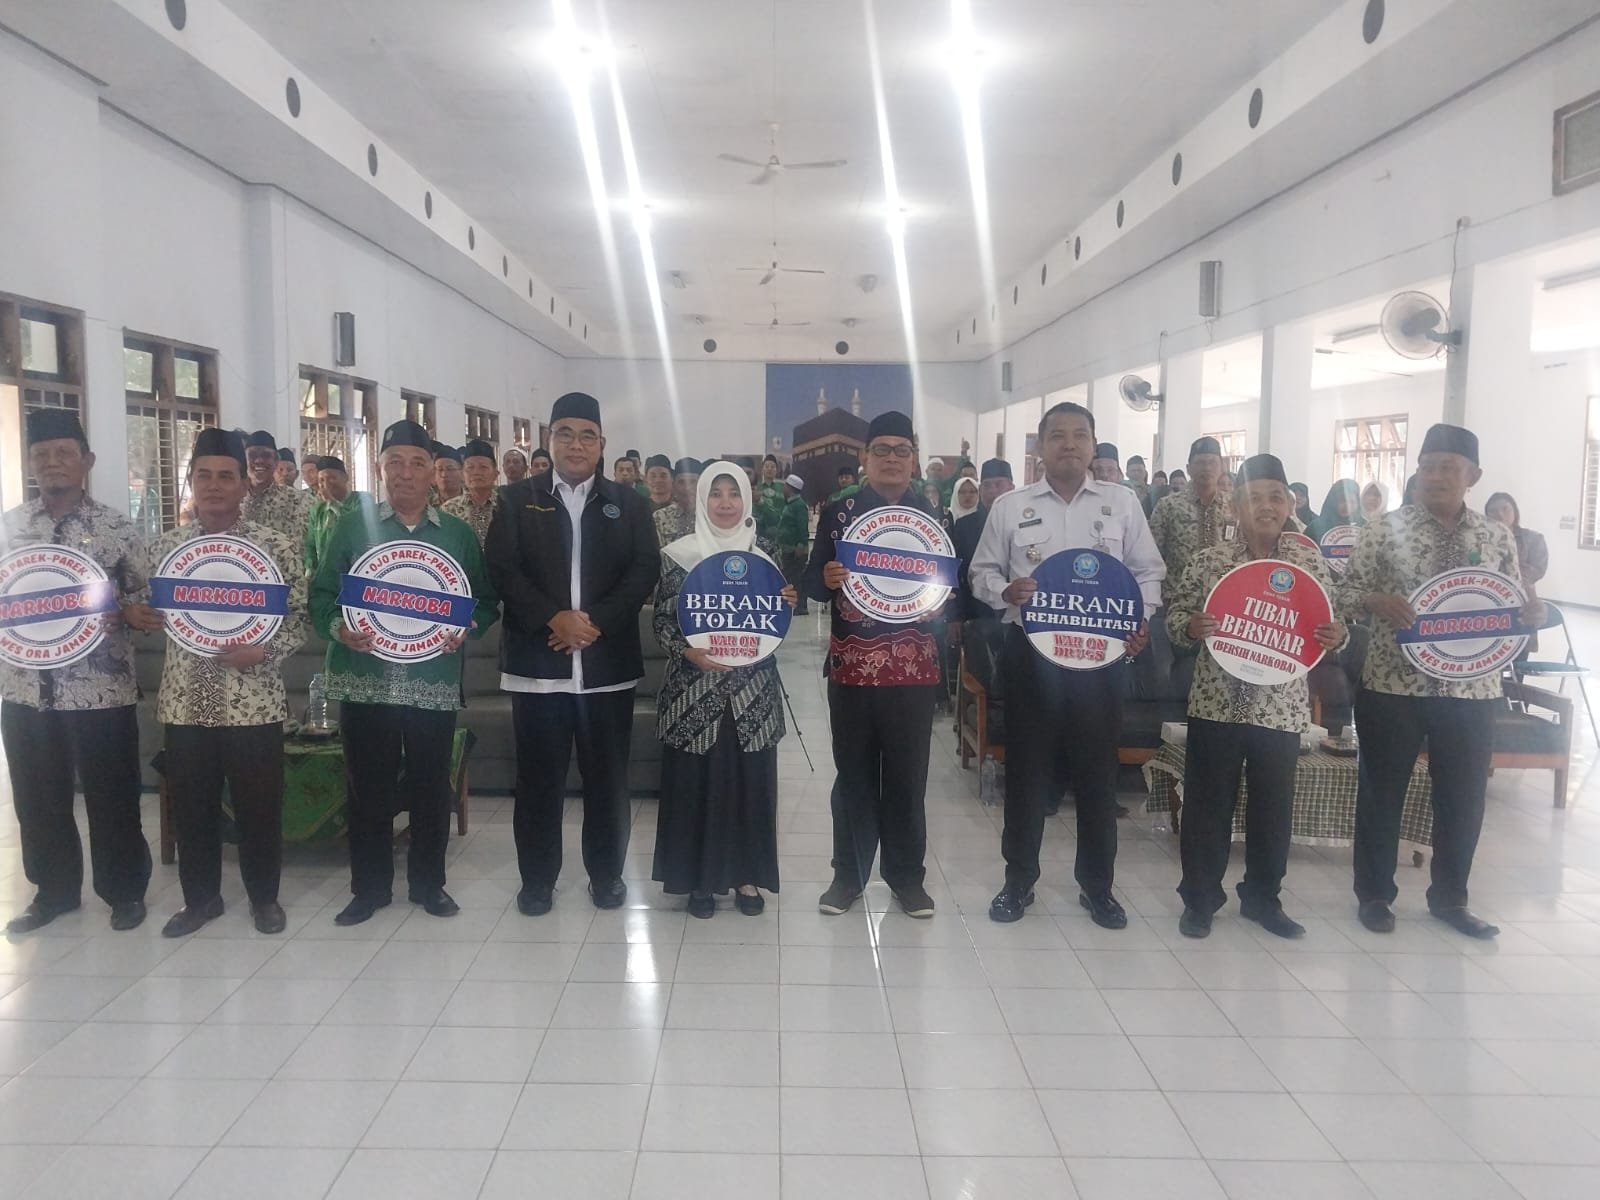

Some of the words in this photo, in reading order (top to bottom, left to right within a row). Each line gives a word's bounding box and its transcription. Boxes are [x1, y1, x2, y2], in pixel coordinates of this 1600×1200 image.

[859, 521, 878, 537] OJO
[878, 514, 942, 546] PAREK-PAREK
[10, 553, 88, 576] PAREK-PAREK
[175, 552, 194, 571] OJO
[195, 543, 268, 575] PAREK-PAREK
[370, 554, 390, 572] OJO
[392, 549, 458, 586] PAREK-PAREK
[856, 550, 938, 576] NARKOBA
[173, 585, 266, 607] NARKOBA
[363, 586, 452, 616] NARKOBA
[685, 593, 784, 613] BERANI
[852, 580, 871, 601] WES
[870, 598, 891, 613] ORA
[1031, 591, 1136, 616] BERANI
[1420, 589, 1439, 608] OJO
[1440, 576, 1513, 600] PAREK-PAREK
[690, 612, 779, 634] TOLAK
[1025, 611, 1138, 632] REHABILITASI
[1243, 596, 1300, 630] TUBAN
[1419, 613, 1512, 636] NARKOBA
[26, 648, 51, 659] ORA
[54, 622, 97, 657] JAMANE
[173, 618, 195, 638] WES
[195, 634, 218, 648] ORA
[376, 636, 398, 651] ORA
[401, 630, 445, 652] JAMANE
[1220, 613, 1305, 656] BERSINAR
[1212, 640, 1251, 661] (BERSIH
[1249, 650, 1296, 675] NARKOBA)
[1419, 650, 1440, 667] WES
[1441, 662, 1464, 673] ORA
[1467, 642, 1512, 672] JAMANE
